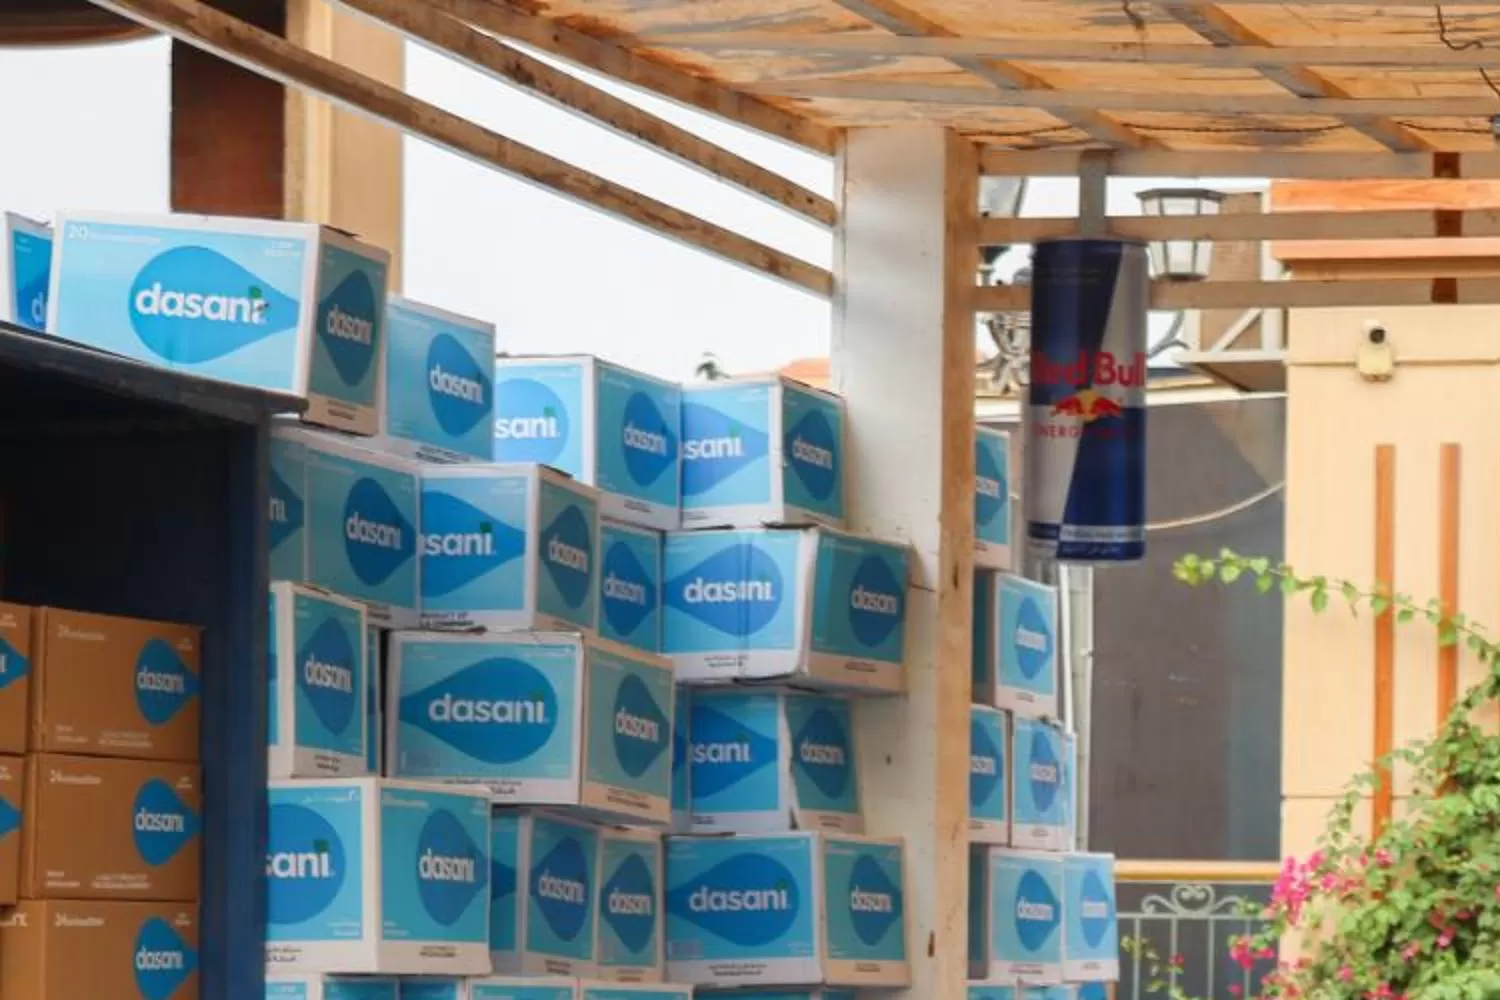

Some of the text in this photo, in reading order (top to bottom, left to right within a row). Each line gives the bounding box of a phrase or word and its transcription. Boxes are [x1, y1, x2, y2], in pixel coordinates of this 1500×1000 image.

[135, 282, 268, 324] dasani
[326, 303, 371, 346] dasani
[429, 365, 483, 405] dasani
[1094, 351, 1145, 387] Bull
[494, 408, 560, 439] sani
[624, 420, 667, 456] dasani
[681, 425, 745, 458] sani
[346, 512, 402, 549] dasani
[420, 522, 496, 556] sani
[305, 656, 353, 693] dasani
[428, 692, 548, 724] dasani
[615, 708, 658, 741] dasani
[690, 736, 752, 763] sani
[135, 808, 184, 832] dasani
[419, 848, 475, 883] dasani
[689, 880, 790, 911] dasani
[135, 947, 183, 969] dasani
